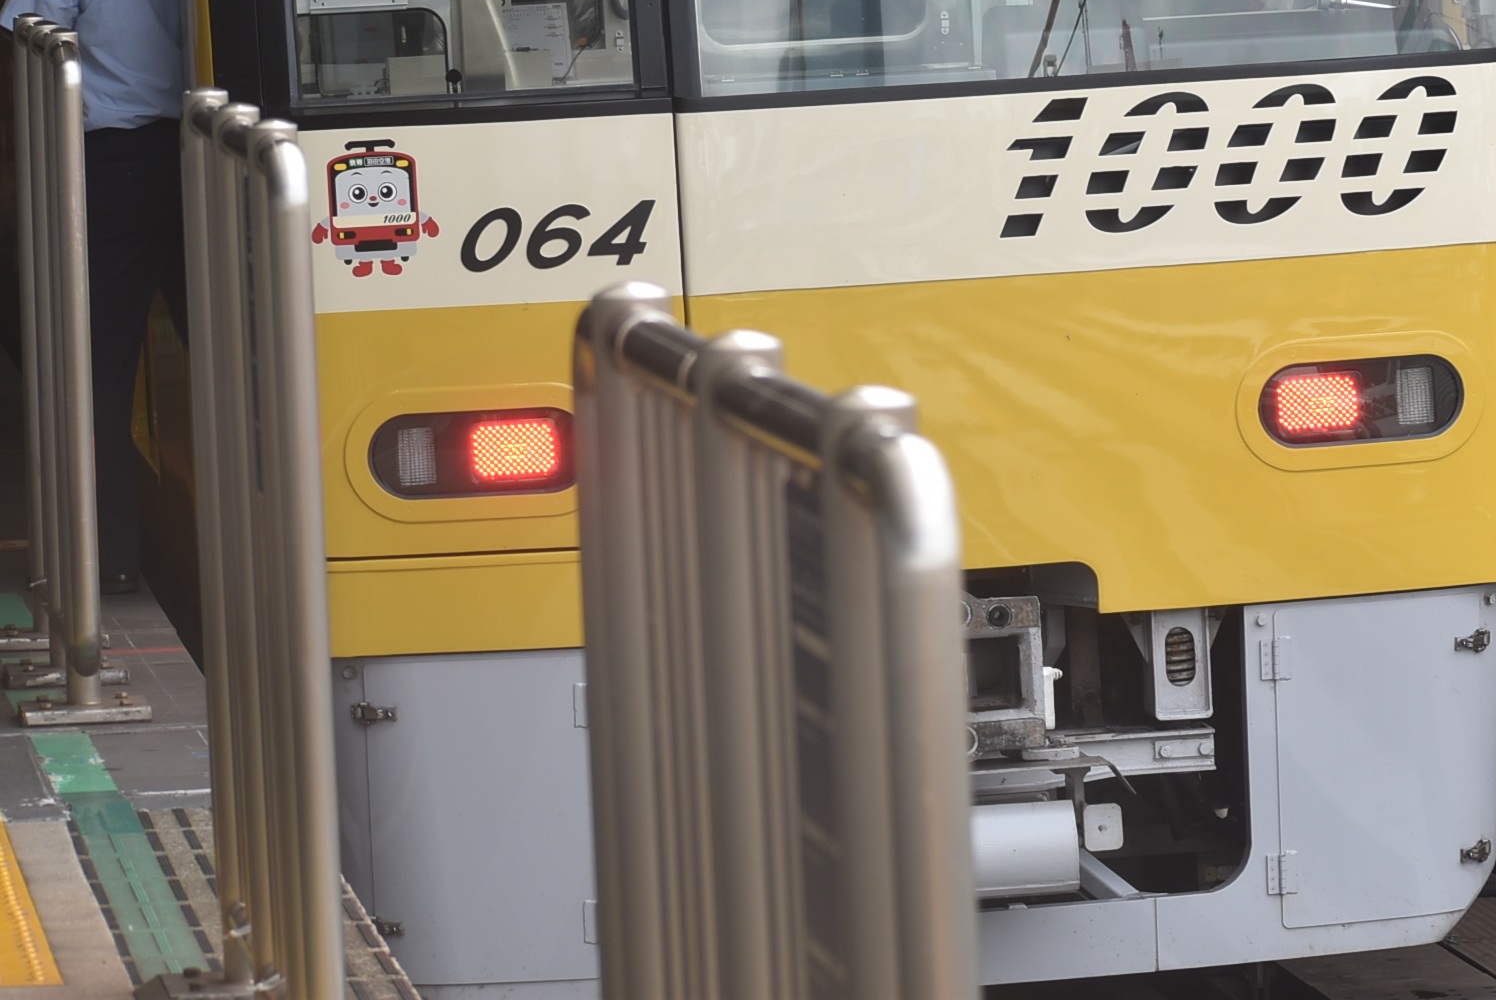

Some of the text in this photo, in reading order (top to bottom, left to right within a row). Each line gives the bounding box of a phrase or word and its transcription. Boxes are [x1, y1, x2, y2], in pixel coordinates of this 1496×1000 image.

[1000, 75, 1458, 239] 1000
[383, 213, 411, 224] 1000
[460, 199, 656, 273] 064
